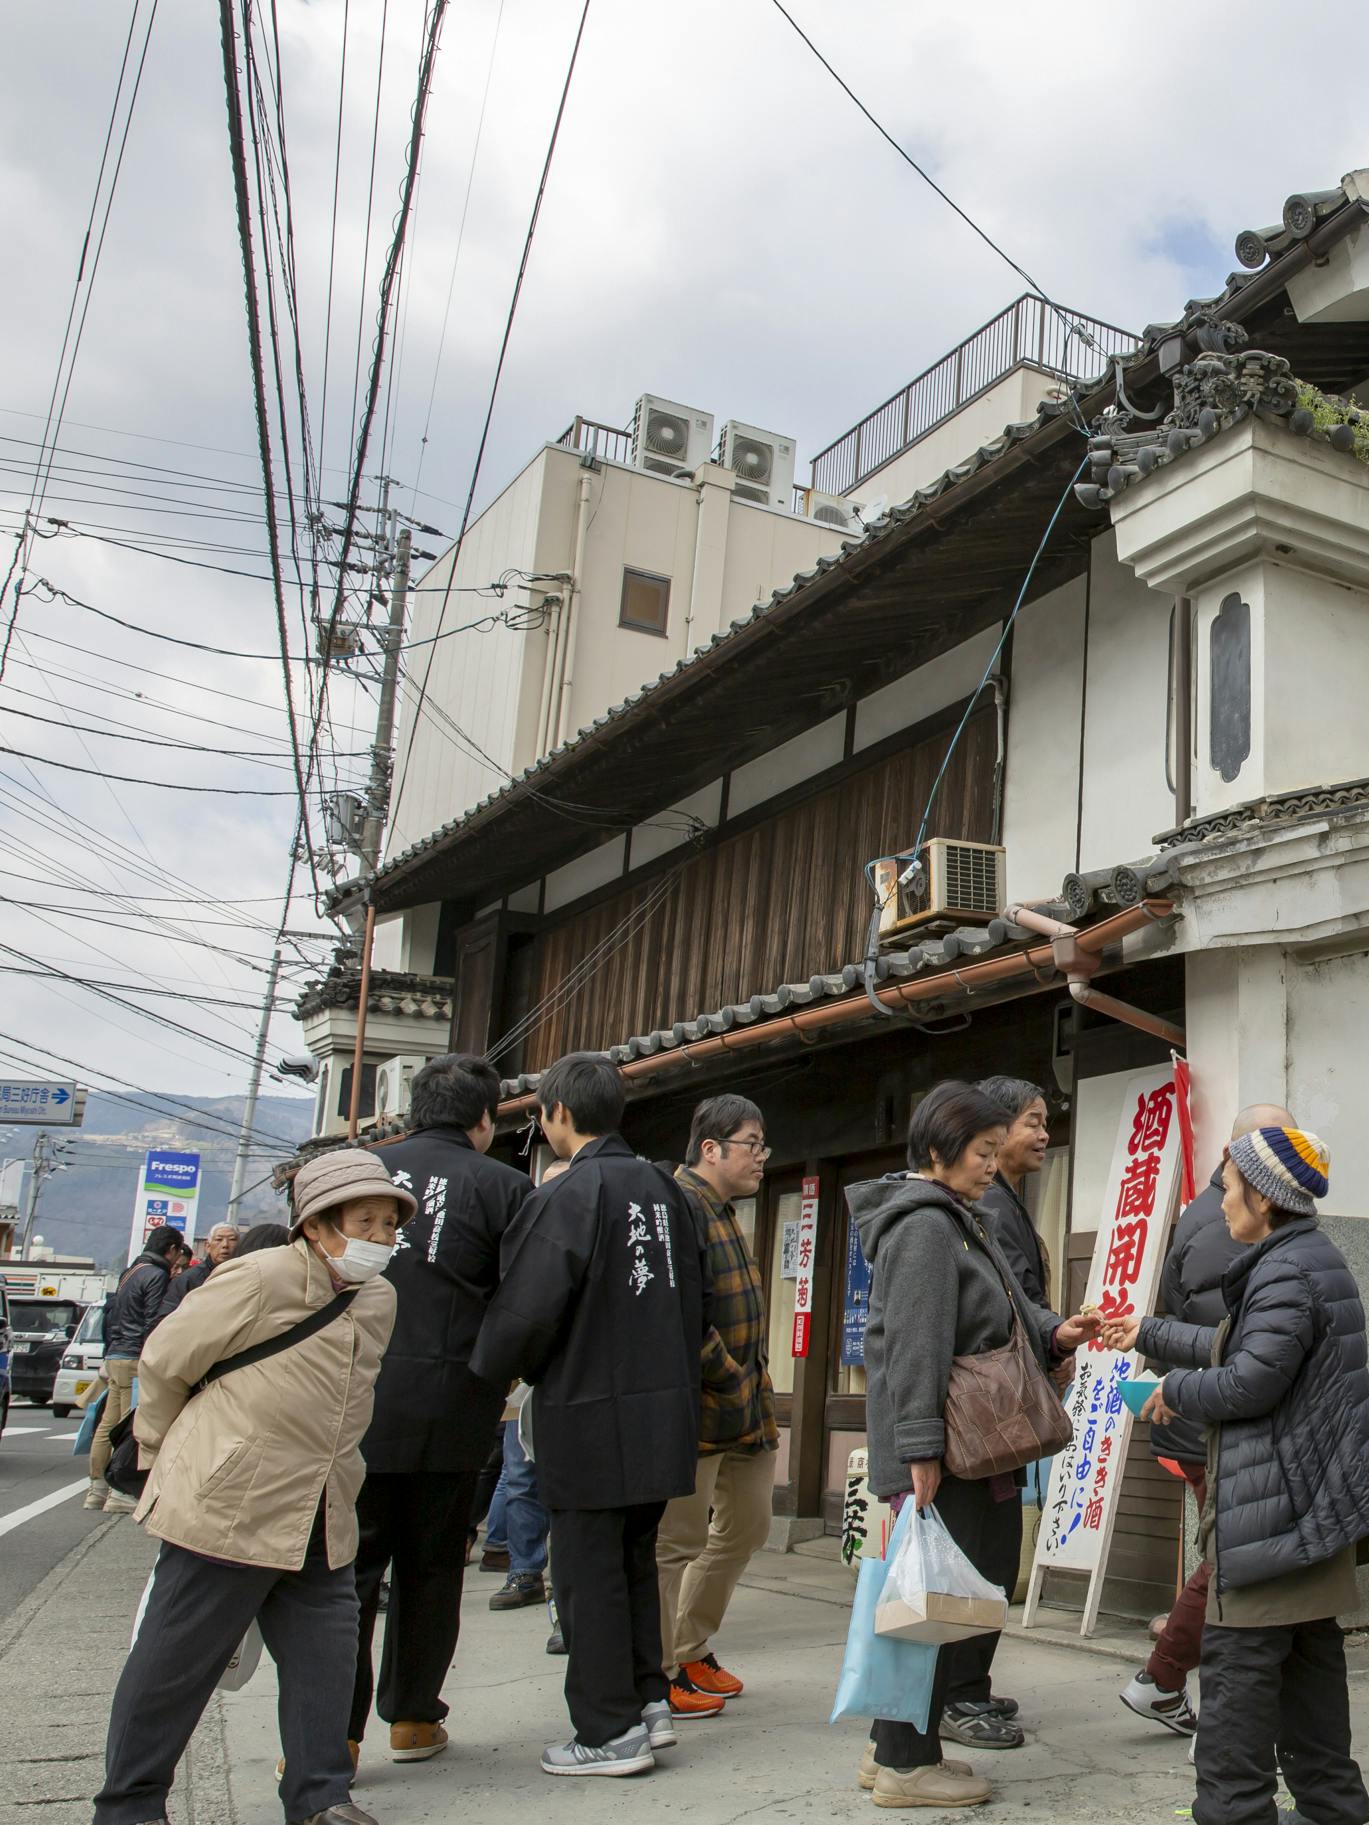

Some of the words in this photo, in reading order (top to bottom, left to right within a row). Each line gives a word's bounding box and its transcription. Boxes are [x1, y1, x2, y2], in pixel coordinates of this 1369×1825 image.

[0, 1086, 50, 1104] 局三好庁舎
[151, 1161, 196, 1174] Frespo
[797, 1203, 814, 1308] 三芳菊
